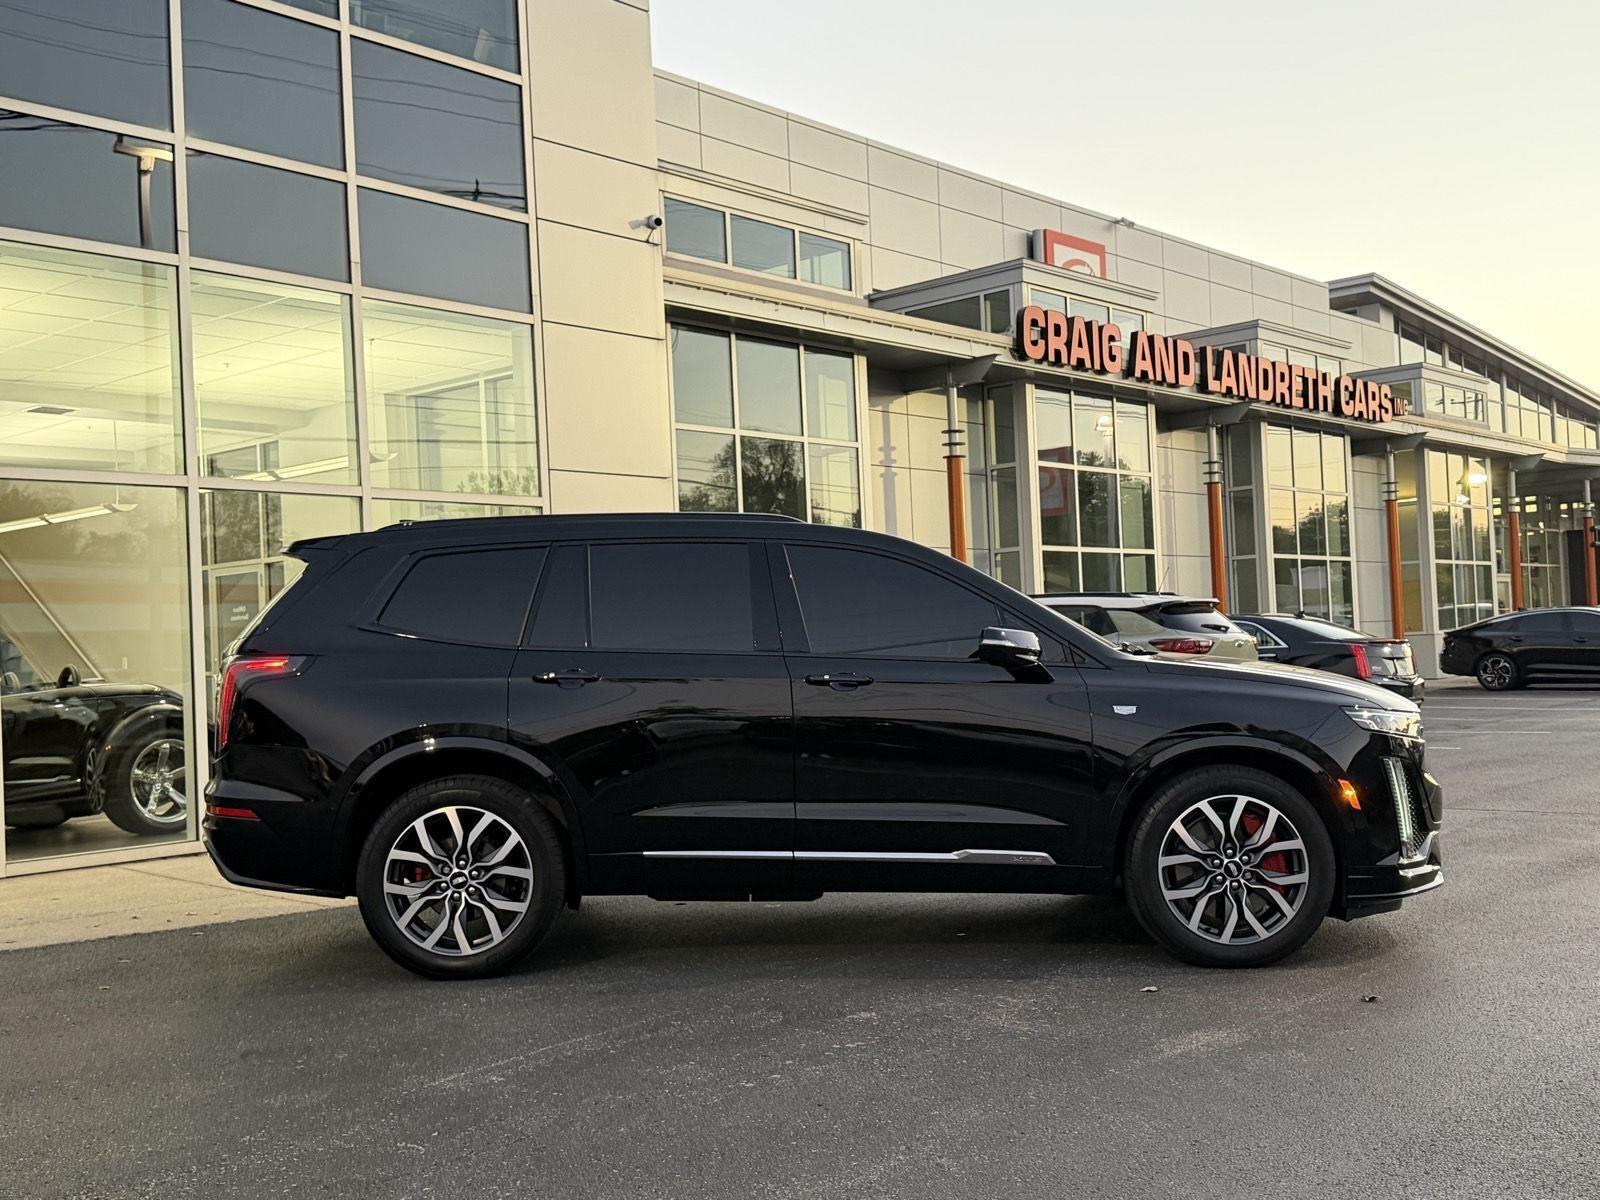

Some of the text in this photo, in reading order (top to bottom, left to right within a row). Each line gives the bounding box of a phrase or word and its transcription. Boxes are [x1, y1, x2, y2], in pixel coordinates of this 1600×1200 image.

[1021, 305, 1122, 374] CRAIG
[1133, 330, 1196, 387] AND
[1205, 345, 1333, 413] LANDRETH
[1339, 375, 1393, 423] CARS
